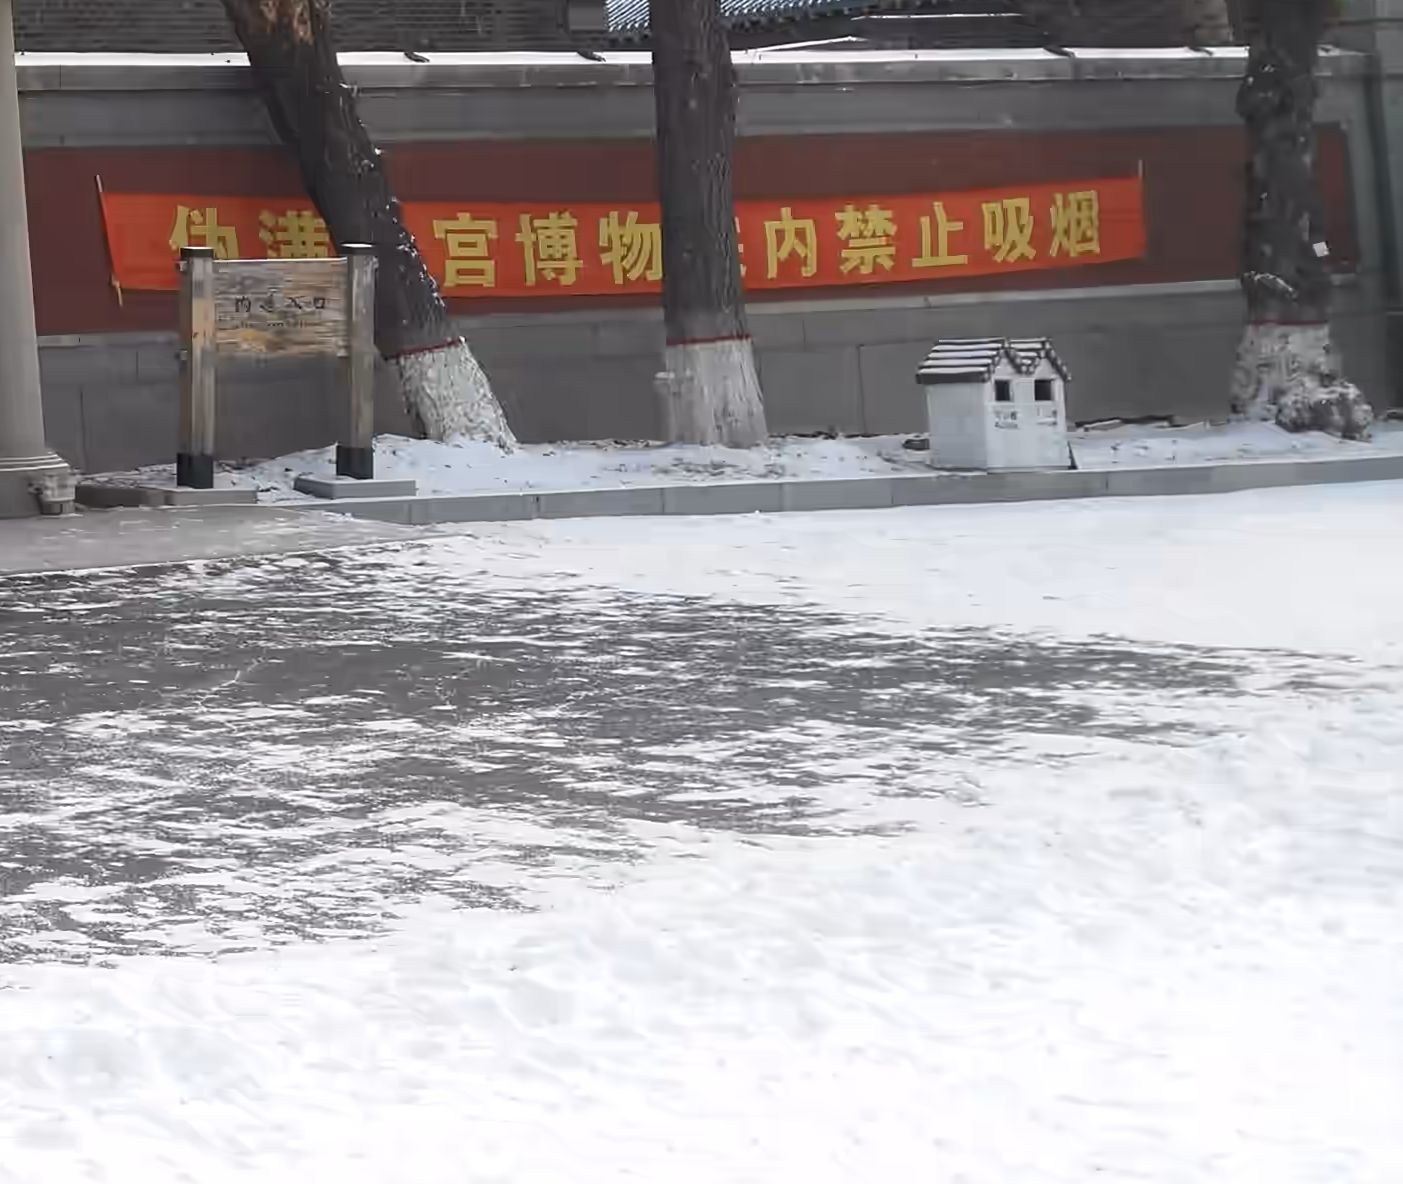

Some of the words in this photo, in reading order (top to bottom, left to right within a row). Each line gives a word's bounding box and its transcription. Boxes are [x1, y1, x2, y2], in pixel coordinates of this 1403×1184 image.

[169, 189, 1101, 288] 伪满宫博物内禁止吸烟
